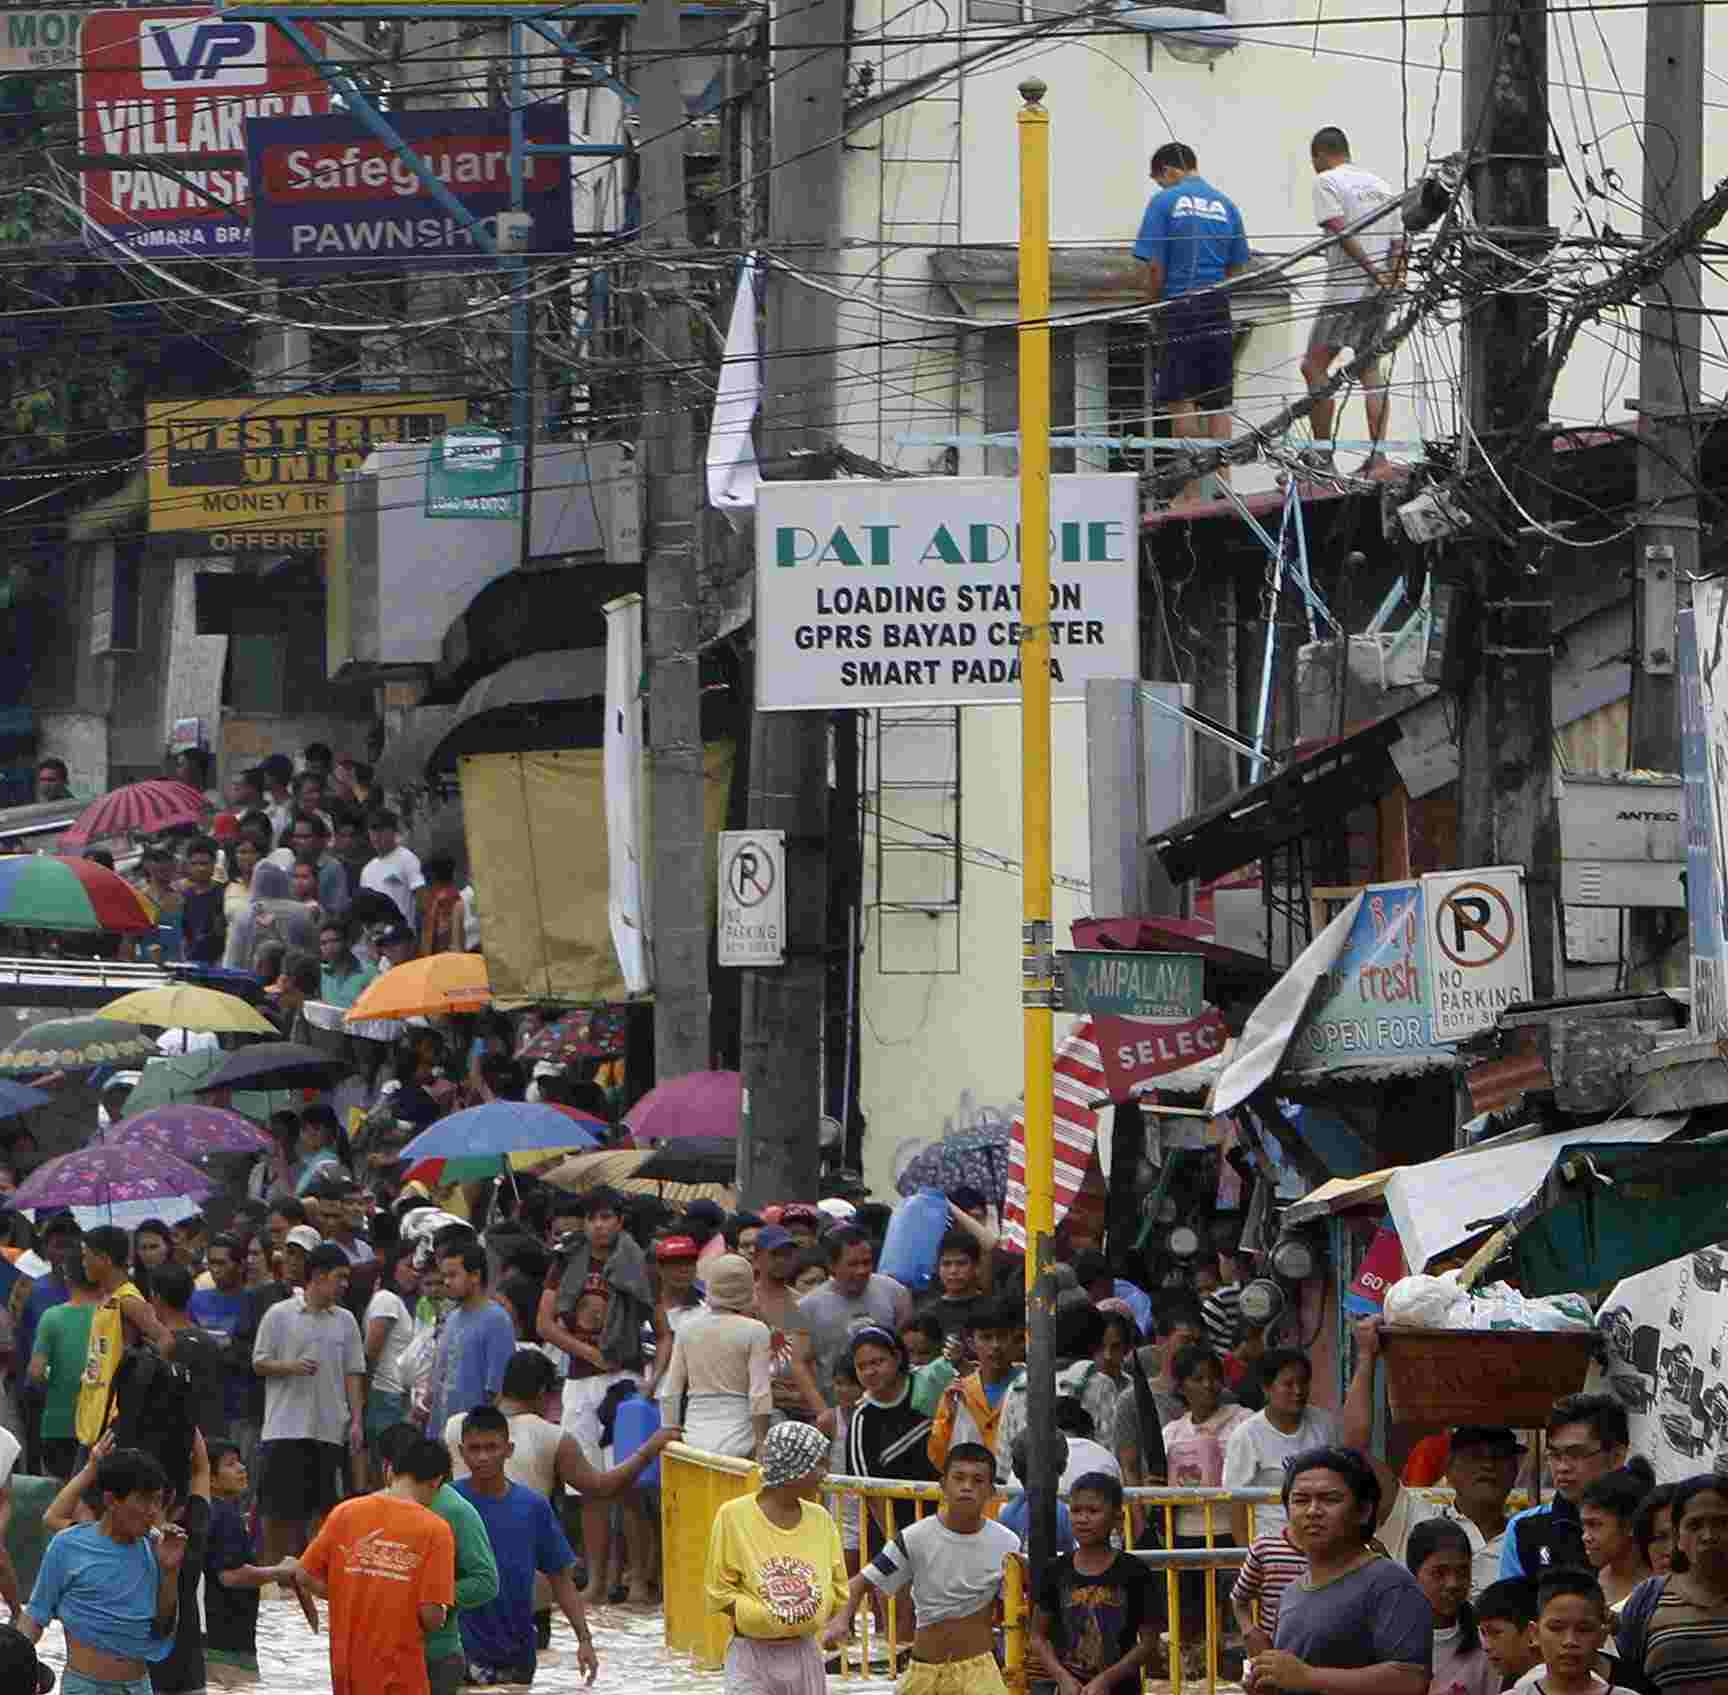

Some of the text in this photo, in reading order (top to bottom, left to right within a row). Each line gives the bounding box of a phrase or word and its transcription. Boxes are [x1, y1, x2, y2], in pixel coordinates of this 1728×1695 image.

[244, 452, 367, 482] UNIO
[202, 492, 290, 513] MONEY
[776, 522, 1126, 568] PAT ADIE
[816, 583, 1082, 615] LOADING STATON
[795, 620, 1105, 650] GPRS BAYAD CETER
[841, 657, 1064, 687] SMART PADAA
[1615, 810, 1679, 823] ANTEC
[1439, 970, 1463, 989] NO
[1440, 986, 1522, 1011] PARKING
[1118, 1023, 1218, 1072] SELEC
